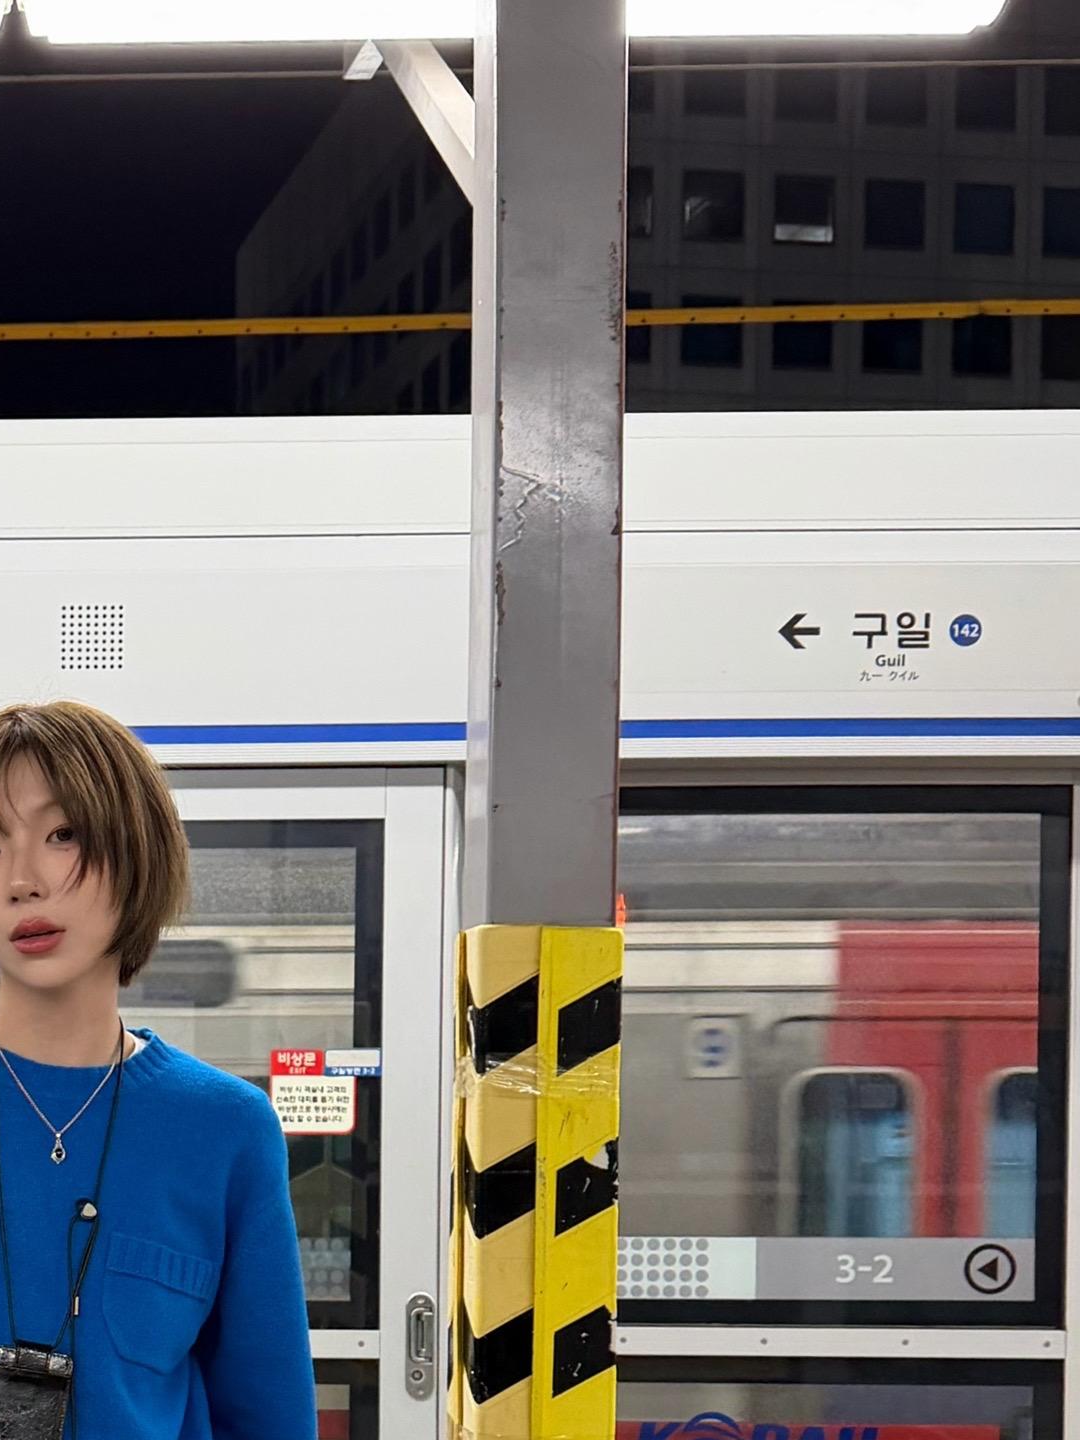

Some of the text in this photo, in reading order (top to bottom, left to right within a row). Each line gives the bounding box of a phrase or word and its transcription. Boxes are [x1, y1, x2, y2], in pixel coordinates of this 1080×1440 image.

[852, 612, 980, 649] 구일 142
[875, 654, 906, 667] Guil
[277, 1052, 316, 1067] 비상문
[835, 1254, 894, 1284] 3-2
